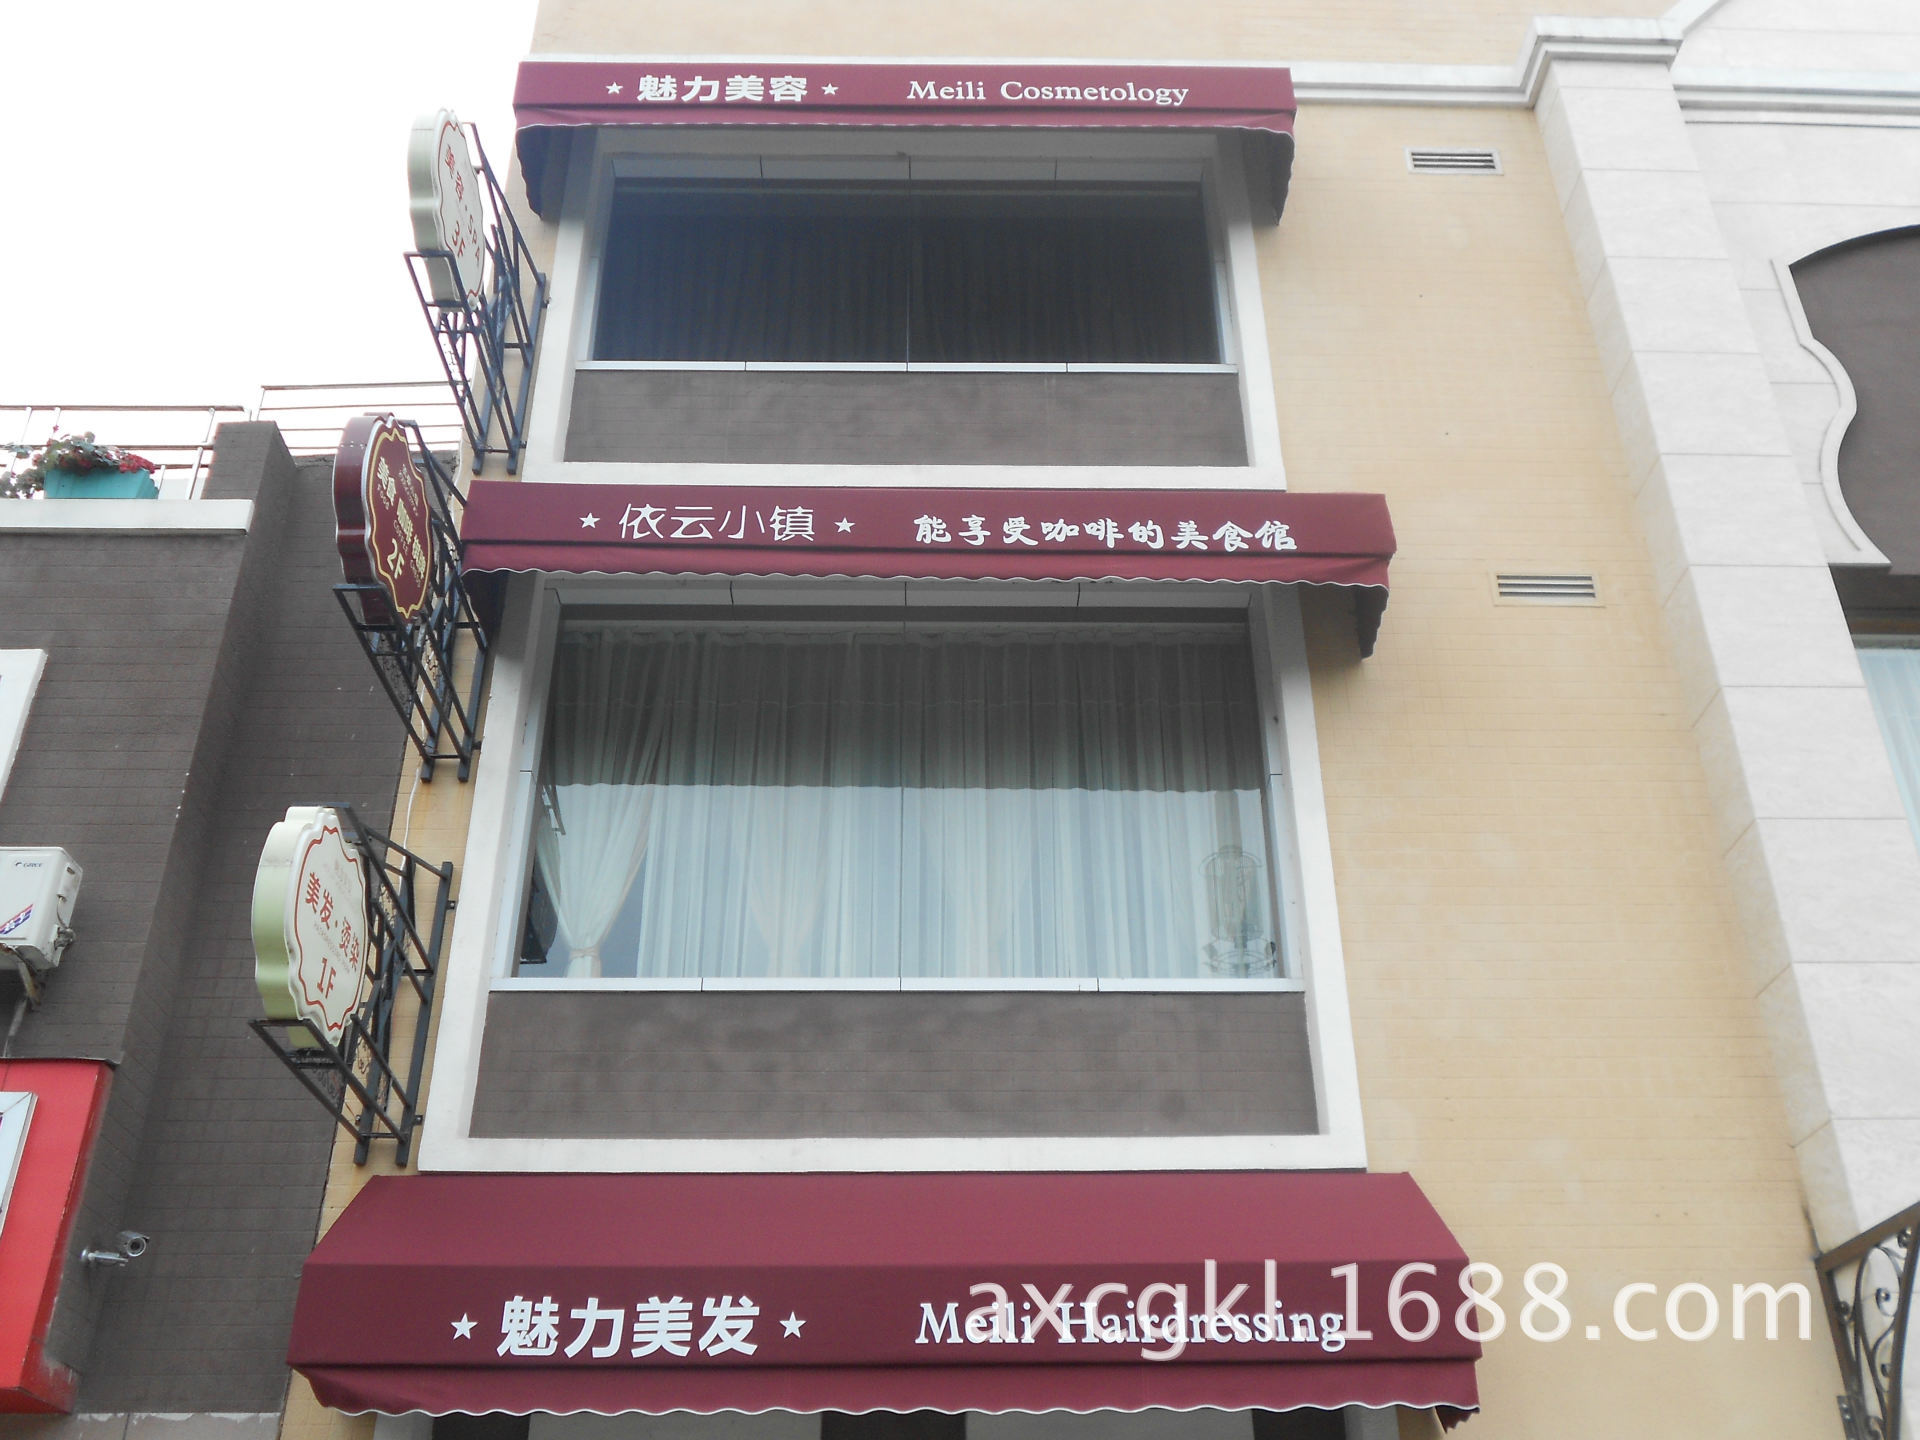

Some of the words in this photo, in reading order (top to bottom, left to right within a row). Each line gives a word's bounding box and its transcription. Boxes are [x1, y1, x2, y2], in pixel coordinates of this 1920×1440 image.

[637, 74, 808, 102] 魅力美容
[906, 80, 986, 100] Meili
[1000, 81, 1189, 106] Cosmetology
[618, 503, 815, 541] 依云小镇
[913, 514, 1298, 553] 能享受咖啡的美食馆
[387, 538, 405, 579] 2F
[316, 956, 337, 999] 1F
[496, 1295, 760, 1358] 魅力美发
[914, 1301, 1035, 1346] Meili
[1057, 1300, 1346, 1353] Hairdressing
